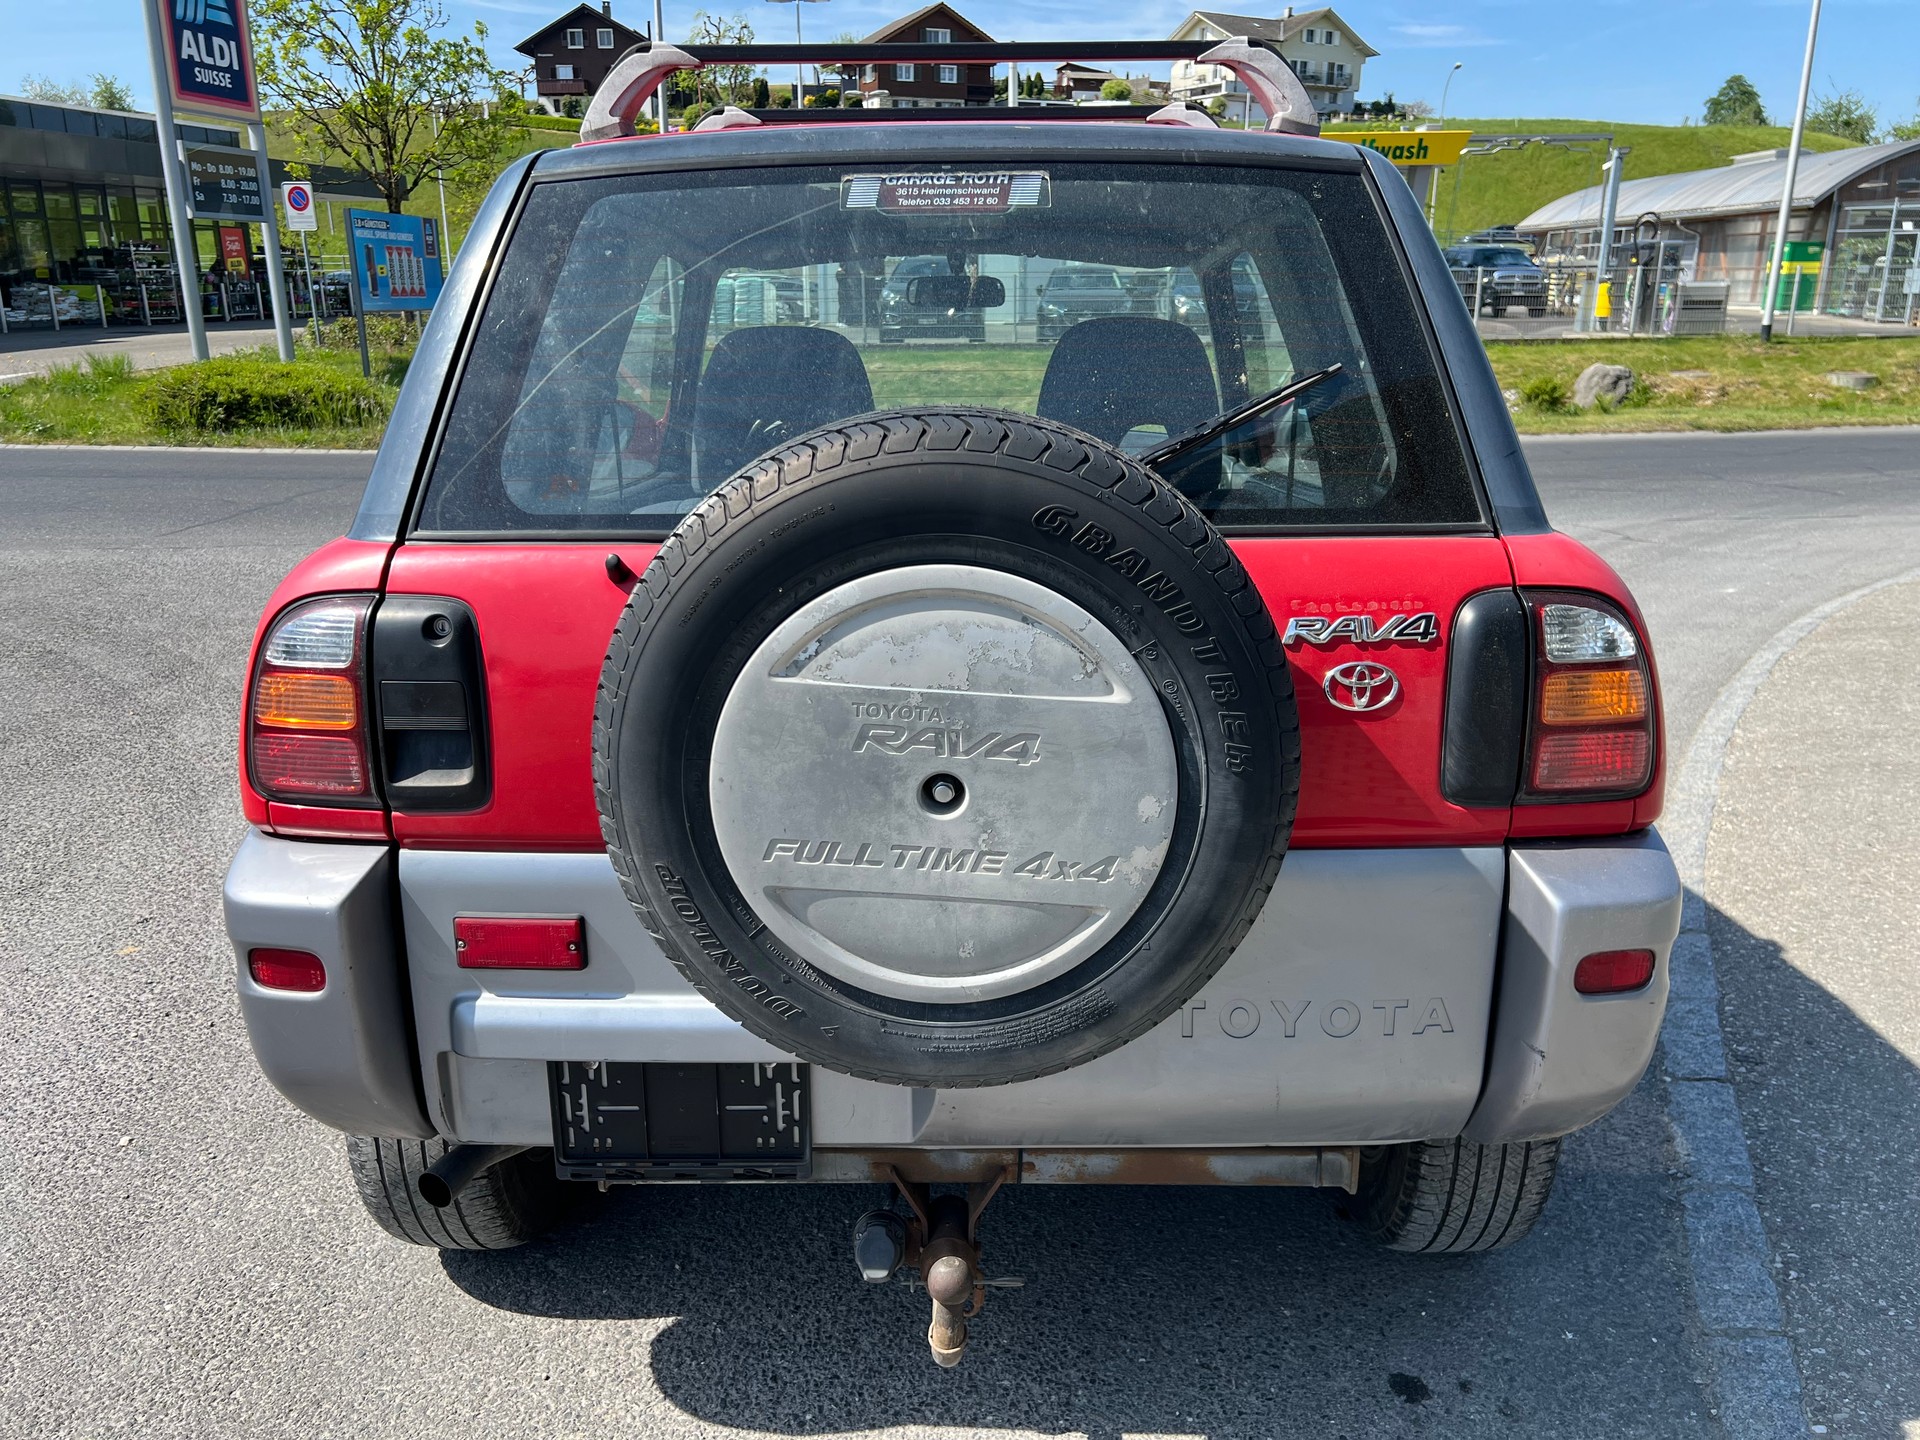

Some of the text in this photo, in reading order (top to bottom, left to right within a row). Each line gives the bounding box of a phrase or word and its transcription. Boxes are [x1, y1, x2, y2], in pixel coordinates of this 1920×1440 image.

[181, 29, 239, 70] ALDI
[194, 66, 232, 88] SUISSE
[191, 162, 202, 171] Mo
[207, 162, 216, 172] Do
[219, 164, 234, 174] 8.00
[238, 167, 256, 177] 19.00
[886, 174, 1010, 186] GARAGE ROTH
[193, 177, 200, 186] Fr
[221, 179, 236, 189] 8.00
[240, 181, 258, 191] 20.00
[921, 186, 1000, 195] Heimenschwand
[195, 191, 205, 201] Sa
[222, 193, 237, 203] 7.30
[242, 195, 260, 205] 17.00
[1282, 612, 1437, 644] RAV4
[852, 702, 945, 723] TOYOTA
[852, 724, 1042, 766] RAV4
[762, 838, 1120, 883] FULL TIME 4x4
[654, 863, 803, 1020] DUNLOP
[1178, 997, 1454, 1038] TOYOTA
